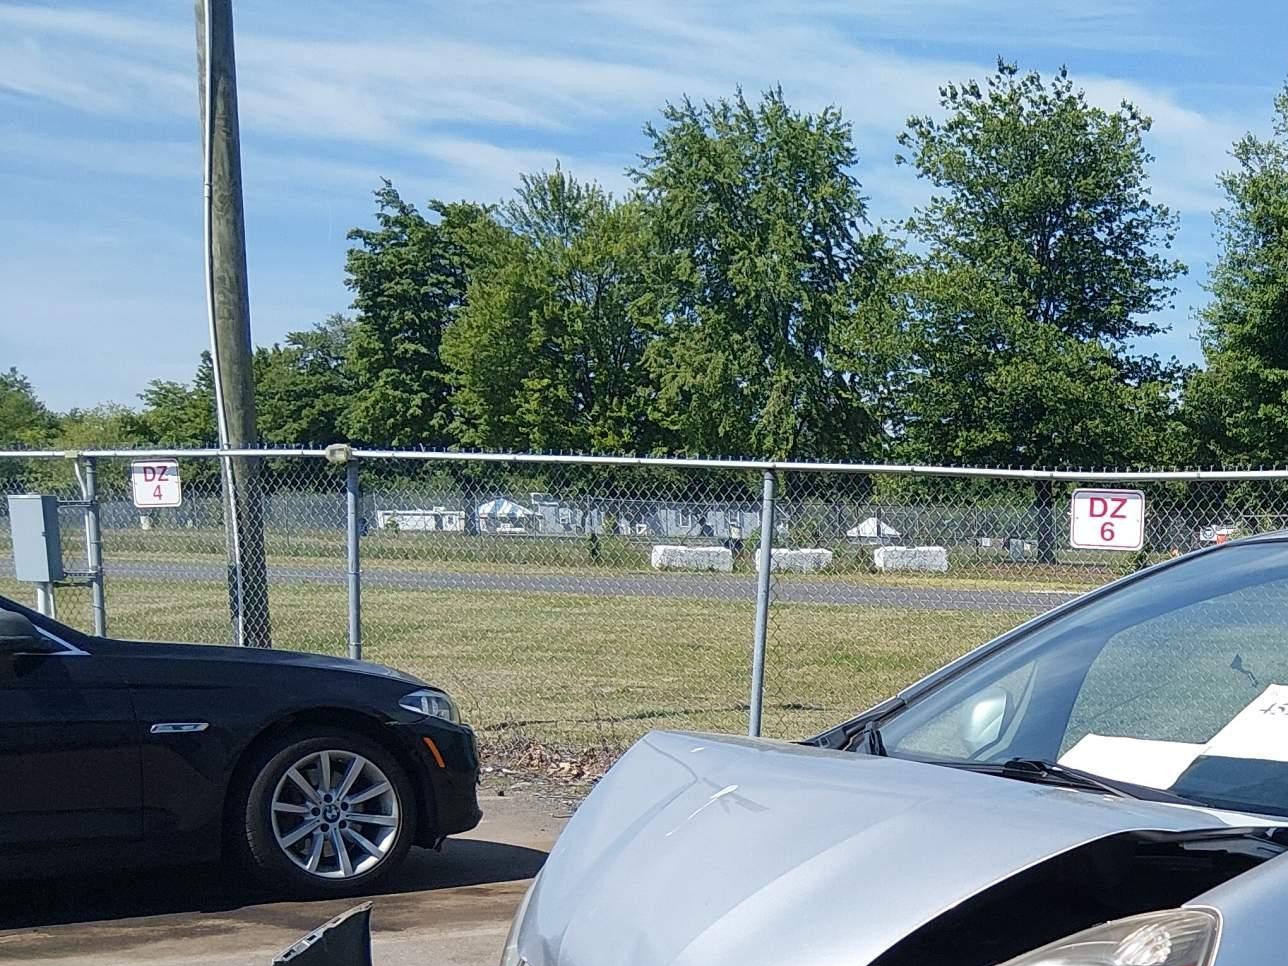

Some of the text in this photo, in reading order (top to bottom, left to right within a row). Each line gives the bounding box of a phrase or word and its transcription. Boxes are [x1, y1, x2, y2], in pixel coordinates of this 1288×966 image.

[143, 466, 169, 482] DZ
[153, 485, 163, 500] 4
[1089, 497, 1127, 518] DZ
[1099, 522, 1115, 541] 6
